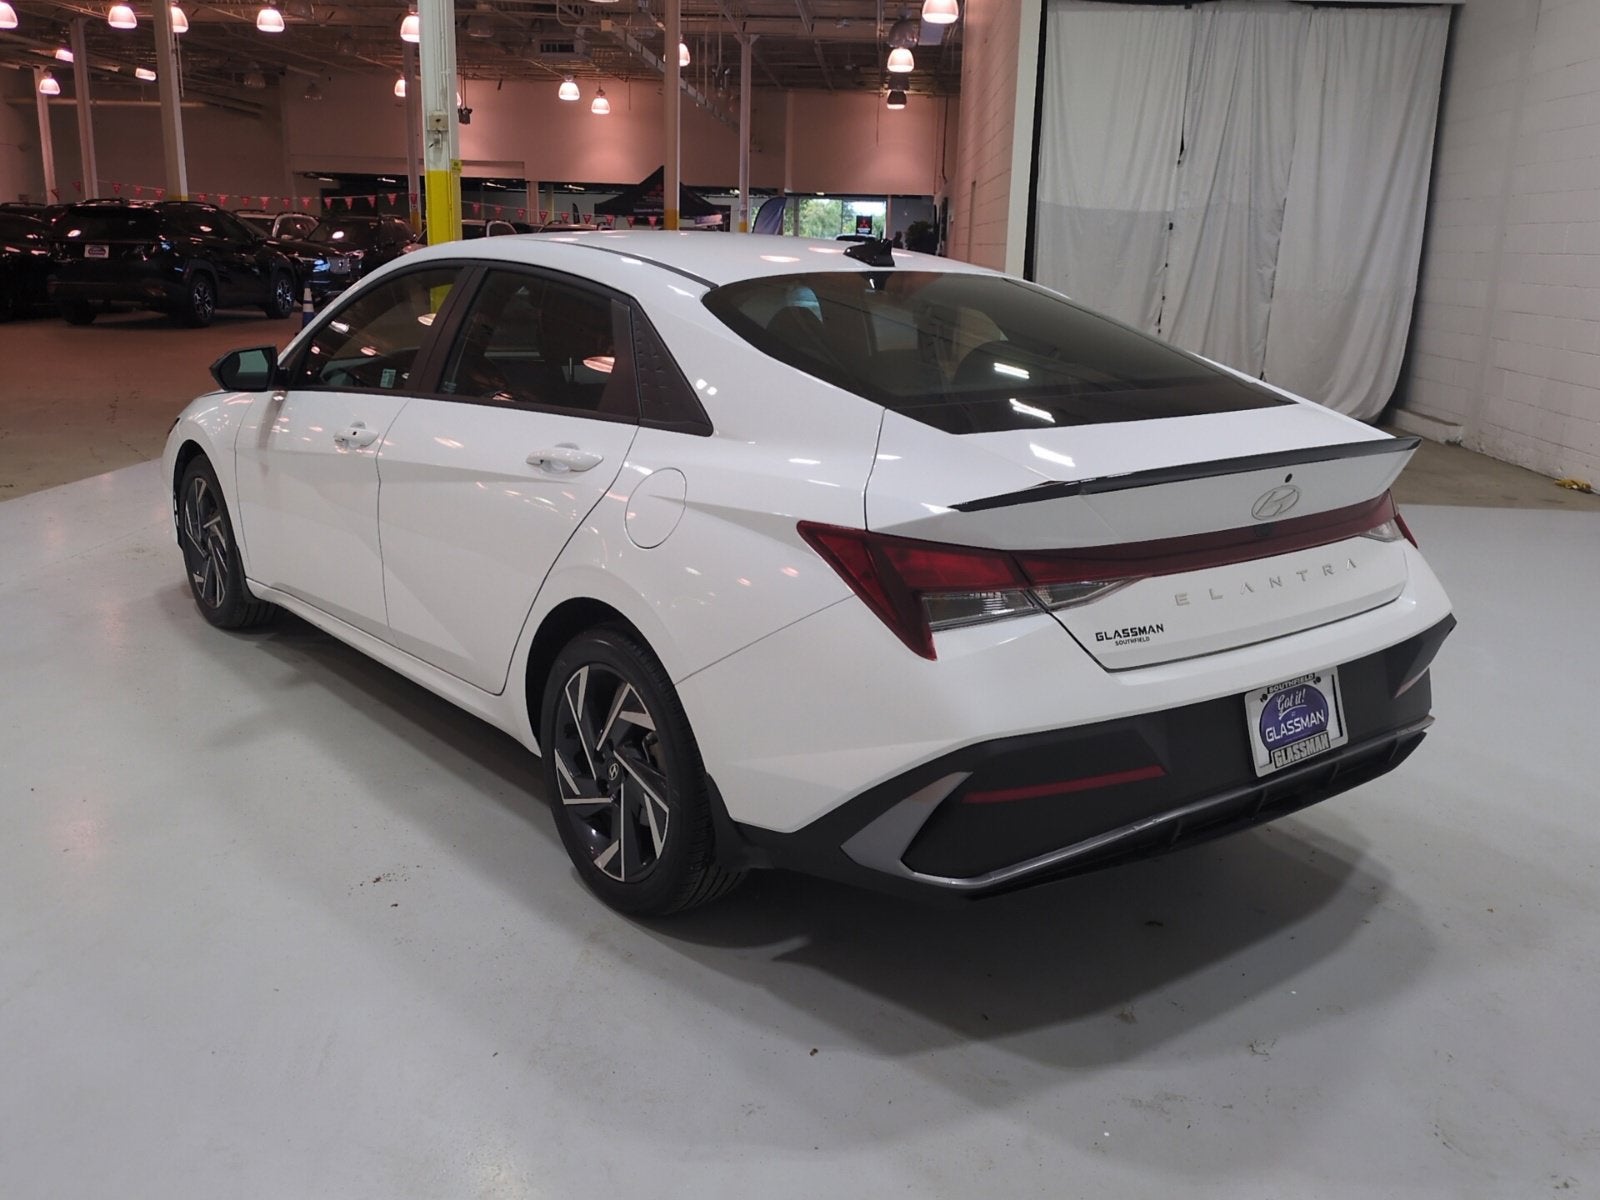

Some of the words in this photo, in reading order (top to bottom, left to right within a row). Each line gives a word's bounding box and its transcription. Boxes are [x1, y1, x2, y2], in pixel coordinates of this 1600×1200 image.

[1174, 557, 1356, 607] ELANTRA
[1095, 623, 1164, 642] GLASSMAN
[1115, 636, 1150, 646] SOUTHFIELD
[1277, 693, 1294, 712] Got
[1265, 709, 1325, 742] GLASSMAN
[1273, 732, 1330, 768] GLASSMAN
